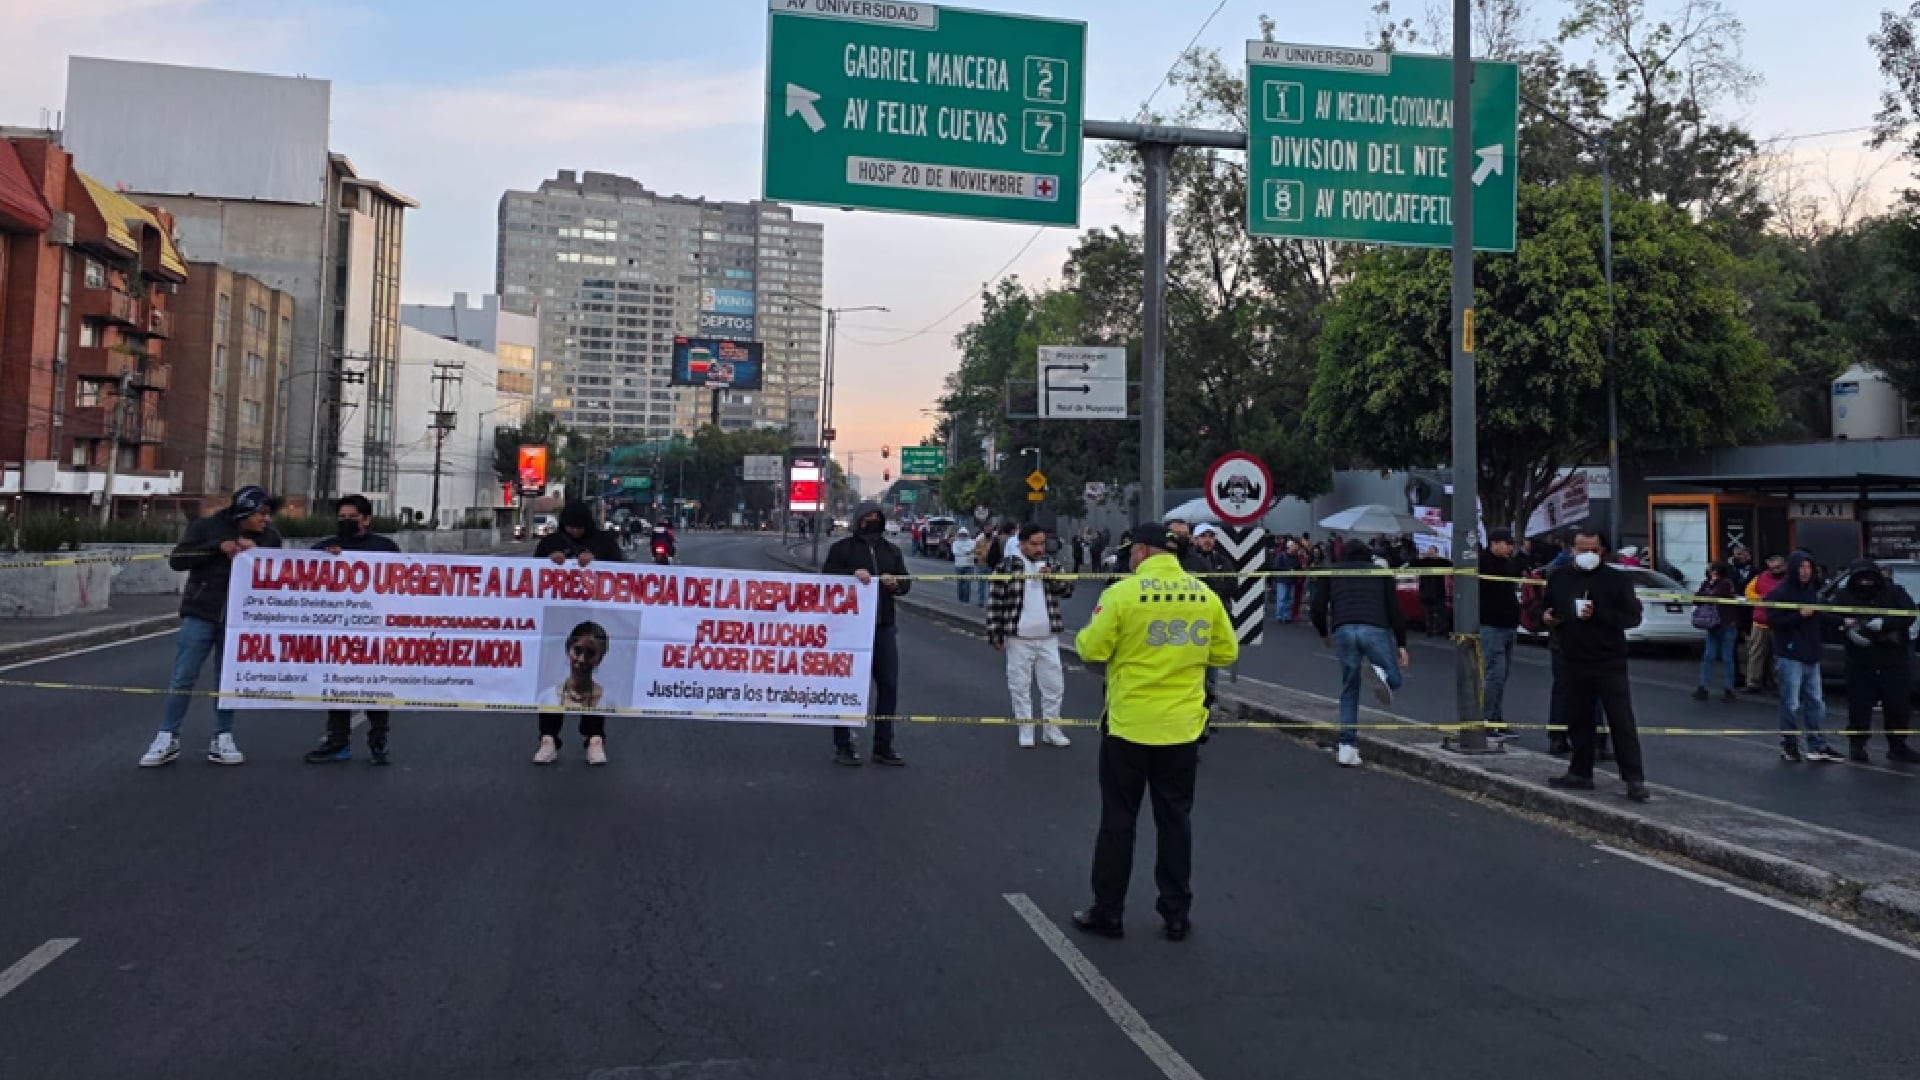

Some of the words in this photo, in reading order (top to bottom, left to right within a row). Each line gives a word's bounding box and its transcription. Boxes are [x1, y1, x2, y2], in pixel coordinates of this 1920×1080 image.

[816, 0, 918, 21] UNIVERSIDAD
[844, 43, 919, 84] GABRIEL
[926, 52, 1009, 92] MANCERA
[1262, 46, 1280, 59] AV
[1286, 48, 1374, 67] UNIVERSIDAD
[1038, 67, 1053, 90] 2
[1315, 90, 1332, 120] AV
[843, 97, 868, 131] AV
[877, 101, 928, 137] FELIX
[938, 107, 1007, 145] CUEVAS
[1035, 120, 1053, 144] 7
[1271, 135, 1358, 172] DIVISION
[1368, 141, 1405, 175] DEL
[1413, 145, 1448, 177] NTE
[858, 161, 897, 182] HOSP
[901, 165, 920, 185] 20
[926, 168, 943, 187] DE
[950, 169, 1024, 195] NOVIEMBRE
[1275, 189, 1292, 212] 8
[1315, 188, 1335, 218] AV
[1342, 189, 1454, 226] POPOCATEPETL
[700, 315, 753, 331] DEPTOS
[1800, 503, 1844, 516] TAXI
[252, 557, 370, 594] LLAMADO
[373, 562, 482, 597] URGENTE
[485, 566, 501, 598] A
[505, 566, 533, 599] LA
[537, 568, 679, 606] PRESIDENCIA
[682, 576, 713, 608] DE
[714, 578, 741, 609] LA
[744, 579, 859, 616] REPUBLICA
[502, 616, 514, 630] A
[516, 617, 536, 630] LA
[695, 619, 754, 646] ¡FUERA
[758, 621, 827, 648] LUCHAS
[1148, 619, 1210, 646] SSC
[237, 633, 276, 663] DRA.
[278, 633, 323, 664] TANIA
[326, 634, 379, 665] HOGLA
[474, 638, 523, 668] MORA
[662, 644, 687, 668] DE
[687, 645, 749, 673] PODER
[752, 648, 776, 674] DE
[777, 649, 798, 675] LA
[647, 680, 704, 699] Justicia
[707, 686, 740, 703] para
[744, 683, 763, 702] los
[766, 684, 861, 708] trabajadores.
